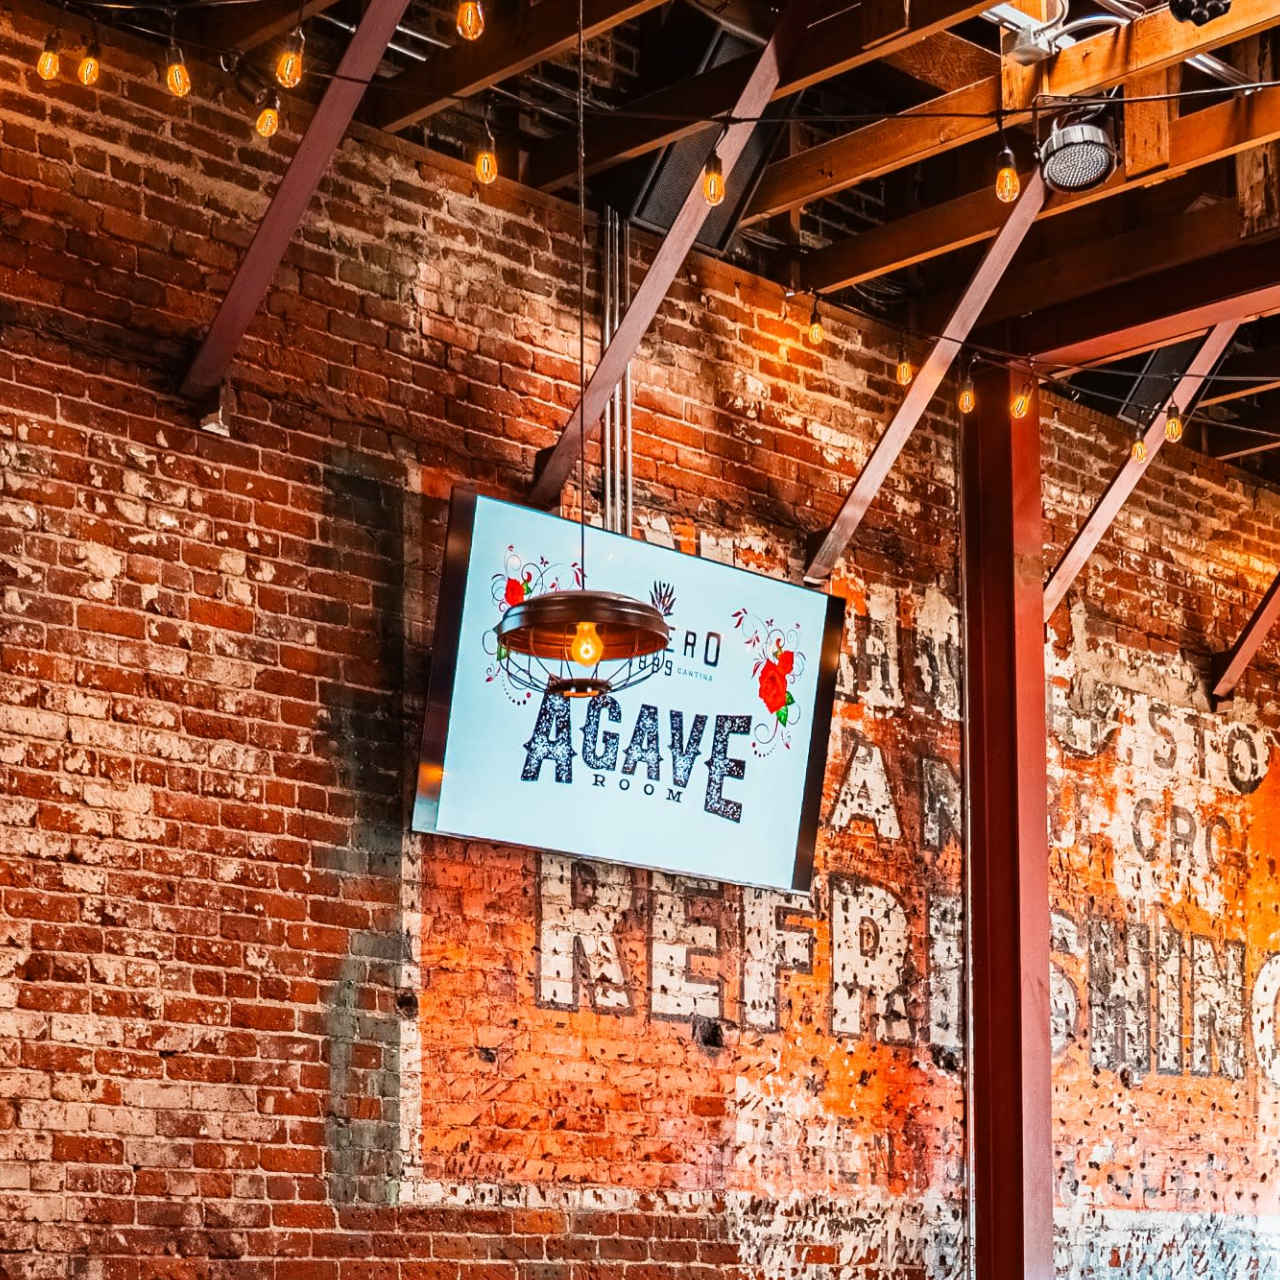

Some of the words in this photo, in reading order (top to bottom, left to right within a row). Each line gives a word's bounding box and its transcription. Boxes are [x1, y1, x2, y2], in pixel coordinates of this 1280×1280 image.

[676, 667, 714, 683] CANTINA
[520, 688, 753, 824] AGAVE
[591, 774, 684, 804] ROOM
